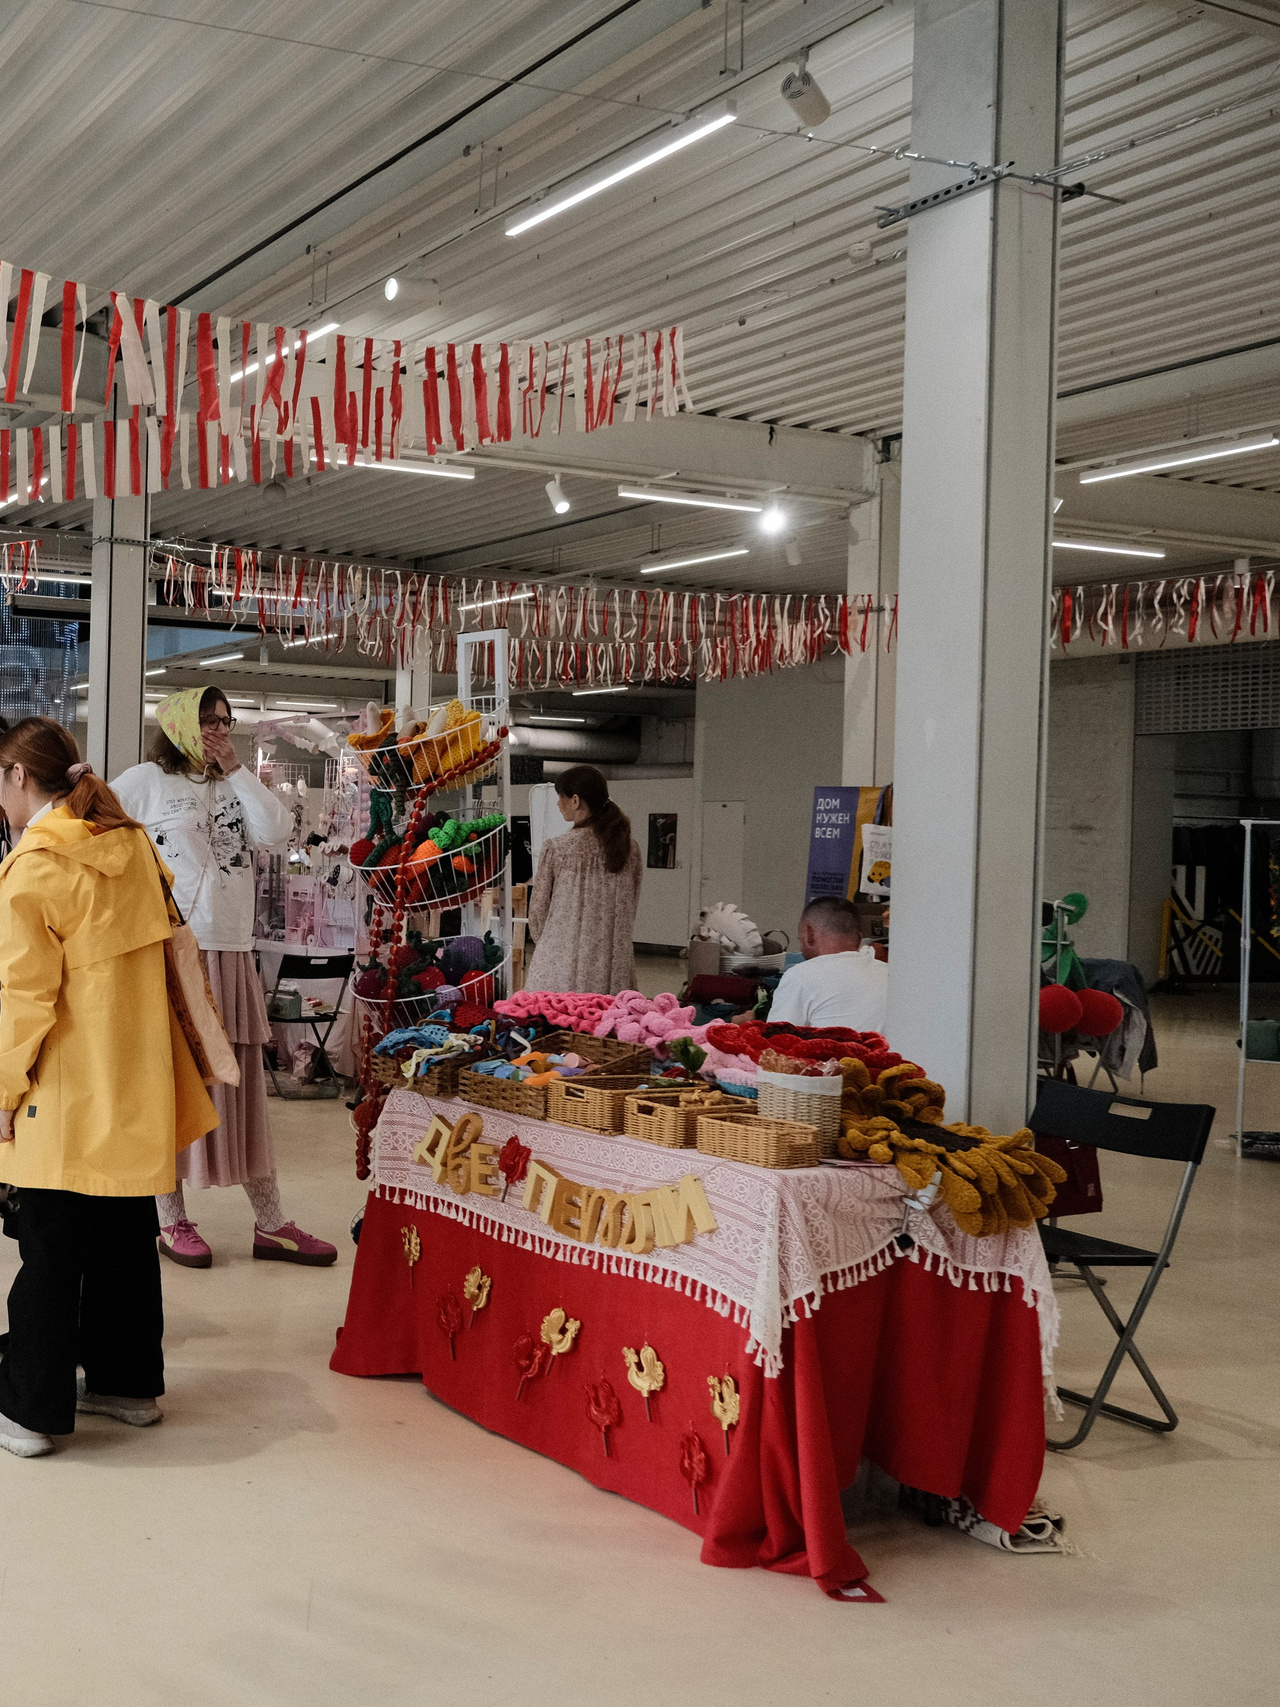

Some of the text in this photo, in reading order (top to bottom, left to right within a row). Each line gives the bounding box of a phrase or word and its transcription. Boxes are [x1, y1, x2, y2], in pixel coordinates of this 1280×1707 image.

[816, 799, 840, 811] ДОМ
[816, 813, 850, 824] НУЖЕН
[815, 827, 840, 838] ВСЕМ
